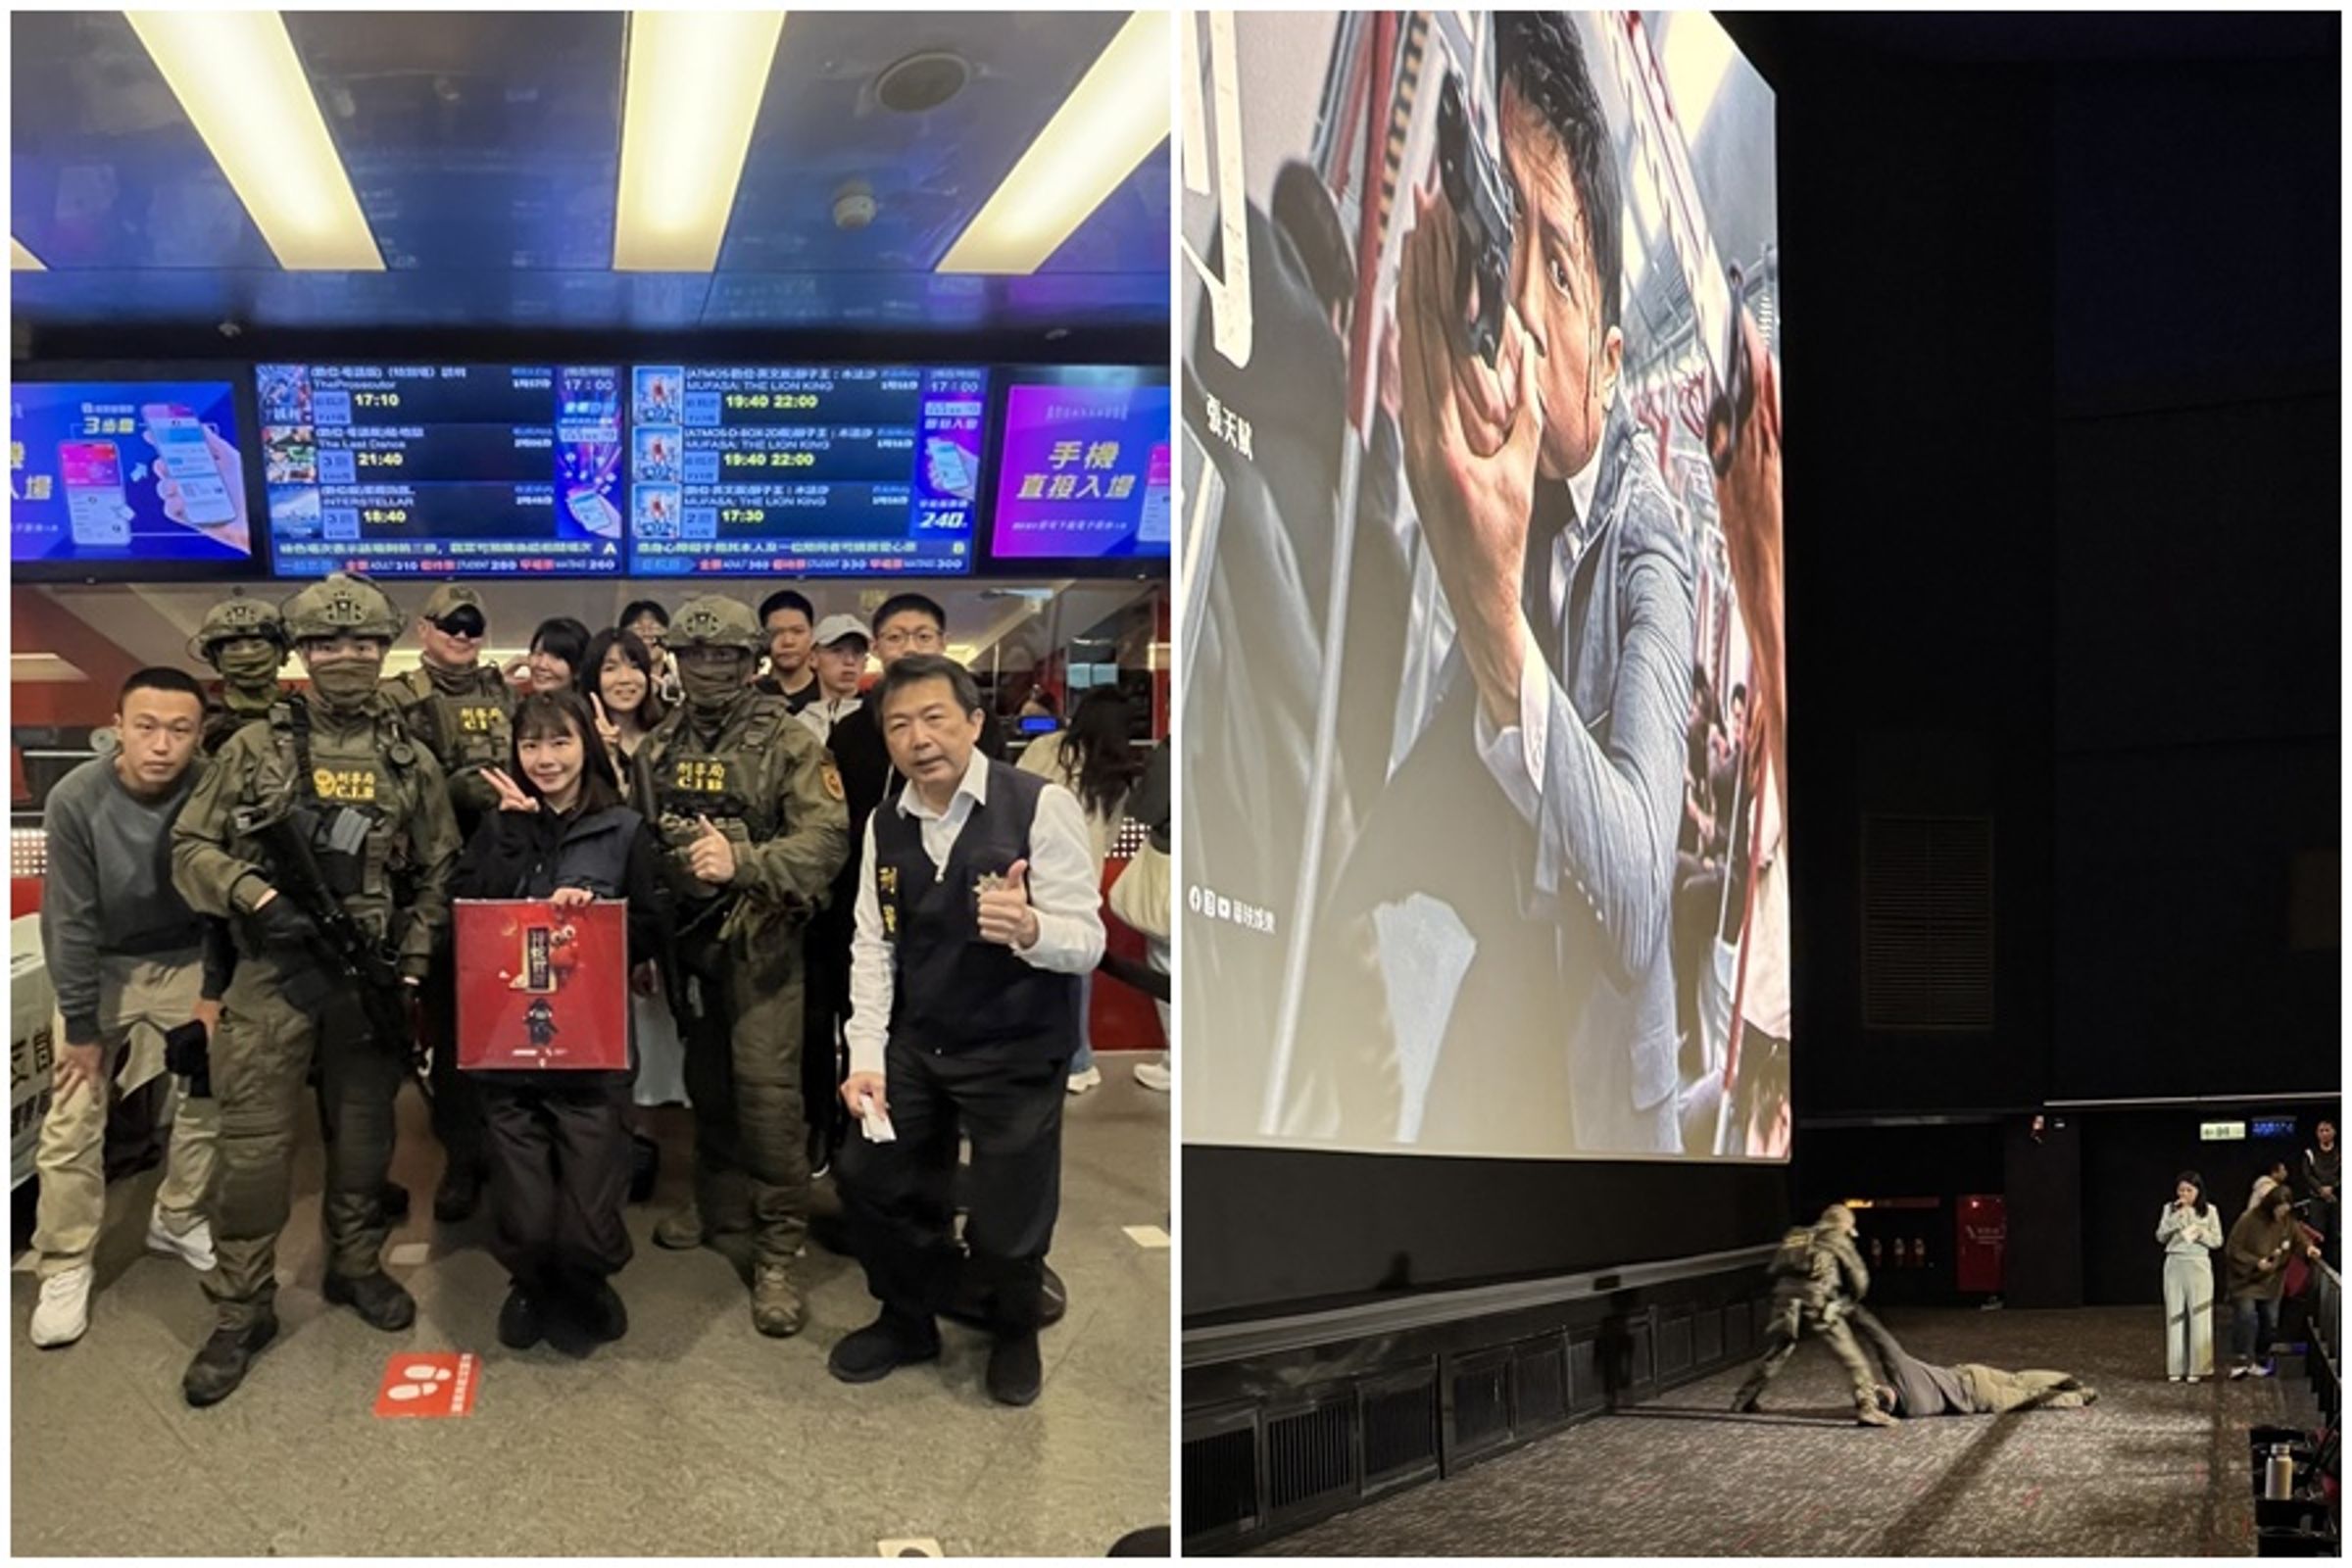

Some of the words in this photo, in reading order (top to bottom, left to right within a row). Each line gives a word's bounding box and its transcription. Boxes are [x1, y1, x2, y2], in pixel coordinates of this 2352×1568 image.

[355, 394, 400, 407] 17:10
[725, 394, 769, 409] 19:40
[773, 394, 819, 409] 22:00
[358, 453, 403, 466] 21:40
[724, 453, 767, 466] 19:40
[770, 453, 815, 466] 22:00
[1048, 441, 1120, 470] 手機
[364, 511, 407, 523] 18:40
[721, 510, 764, 522] 17:30
